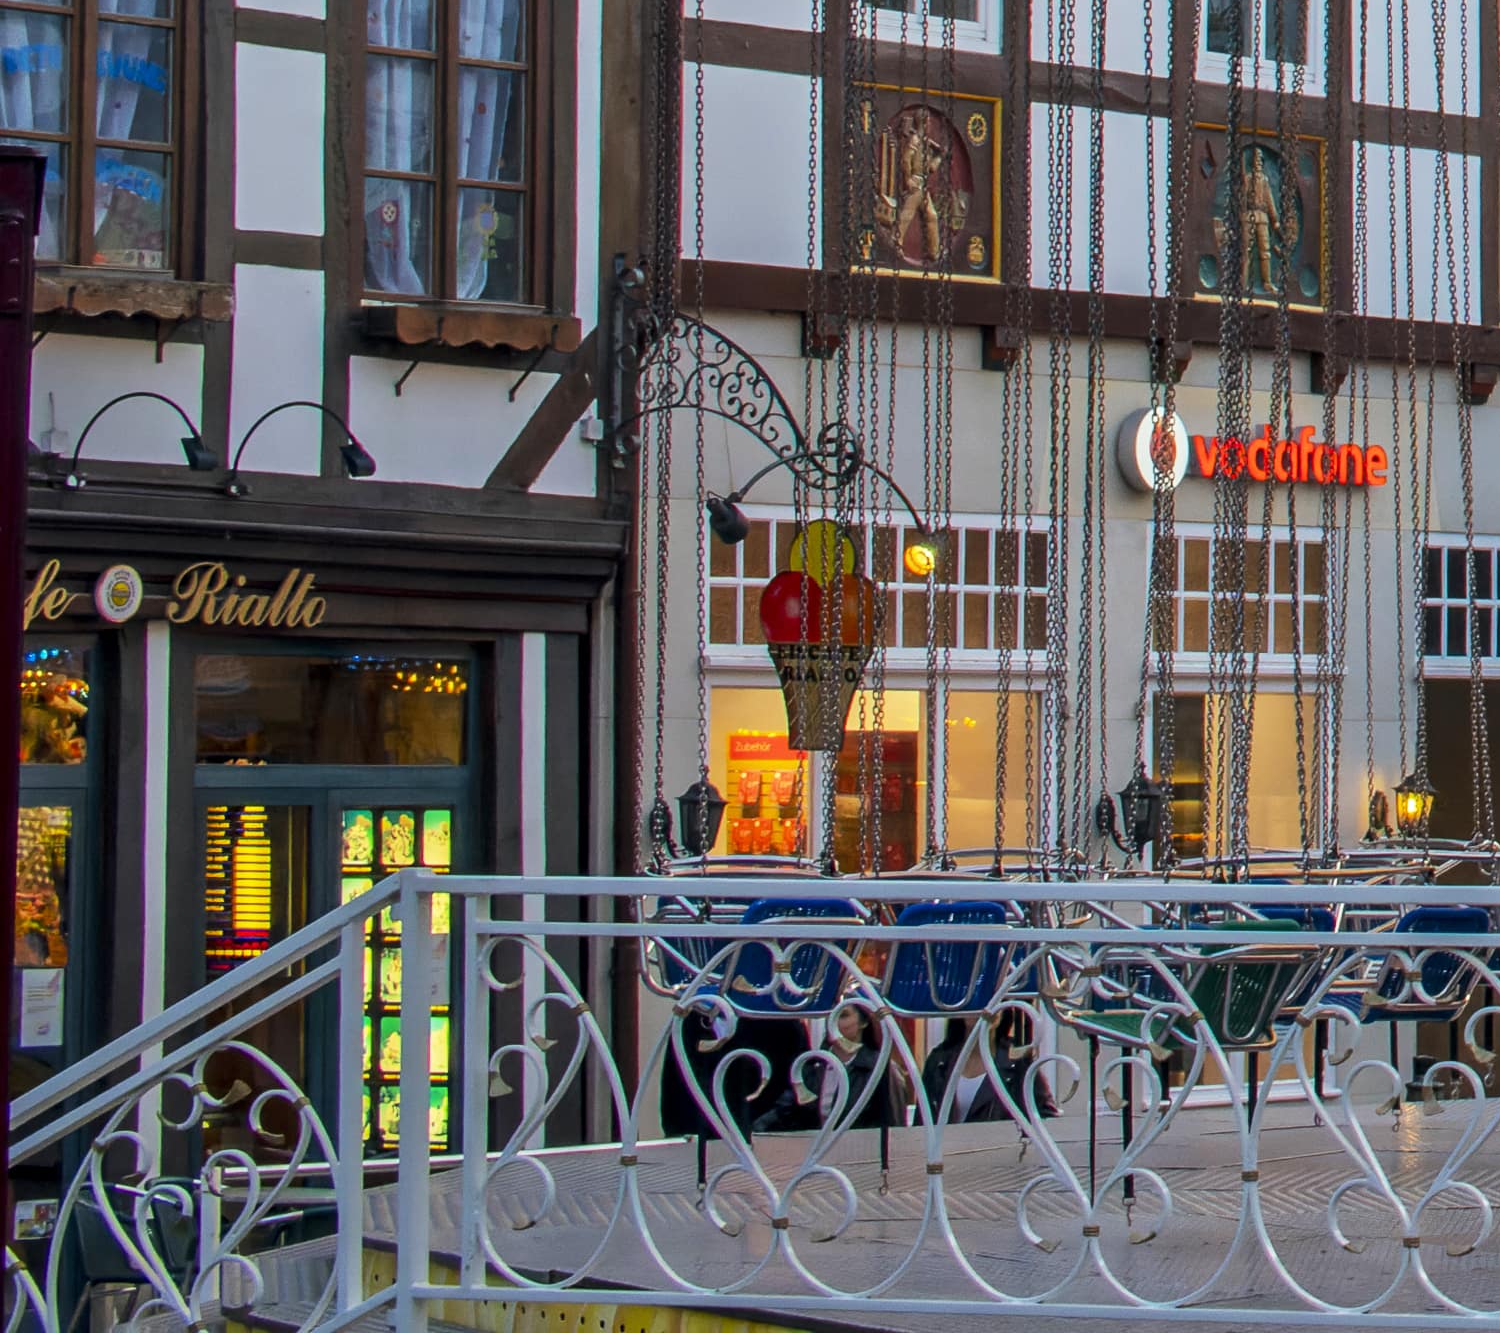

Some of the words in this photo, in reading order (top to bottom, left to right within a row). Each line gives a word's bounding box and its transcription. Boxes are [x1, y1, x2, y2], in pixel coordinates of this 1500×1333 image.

[1192, 423, 1388, 486] vodafone
[166, 561, 327, 628] Rialto
[777, 644, 861, 662] EISCE
[781, 665, 857, 683] RIAO
